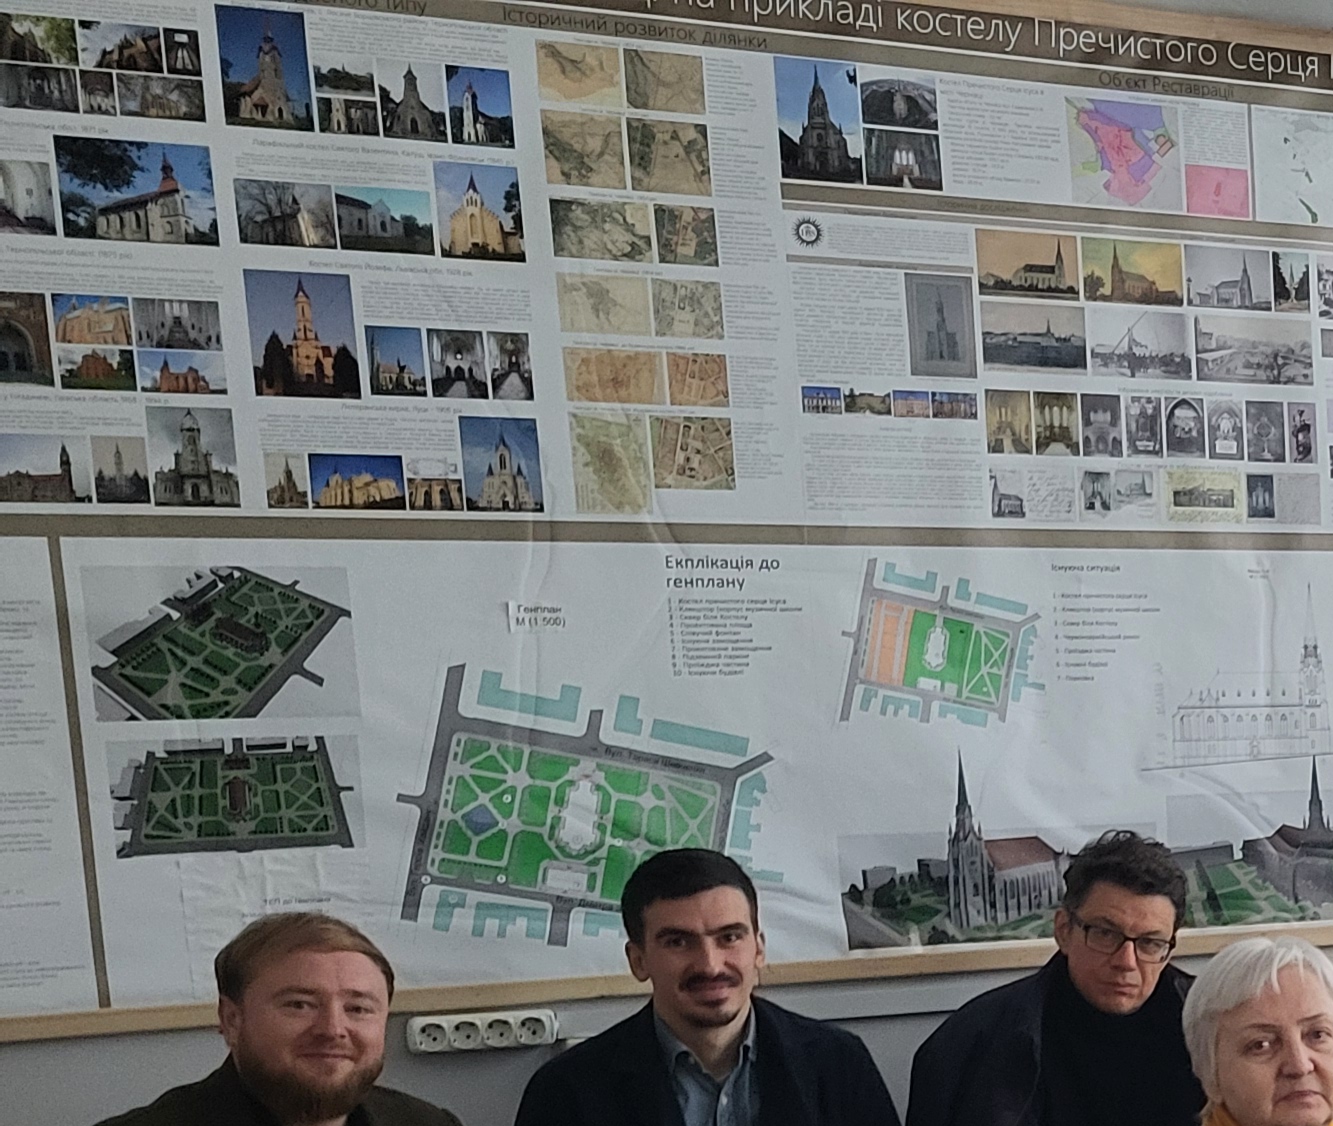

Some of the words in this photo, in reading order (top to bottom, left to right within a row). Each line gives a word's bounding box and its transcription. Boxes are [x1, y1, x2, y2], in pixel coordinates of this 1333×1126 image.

[503, 6, 607, 31] Історичний
[614, 20, 696, 41] розвиток
[702, 30, 768, 49] ділянки
[730, 0, 884, 32] прикладі
[896, 6, 1023, 51] костелу
[1033, 17, 1217, 66] Пречистого
[1226, 42, 1319, 82] Серця
[1099, 71, 1147, 90] Об'єкт
[1152, 78, 1234, 100] Реставрації
[665, 554, 754, 571] Екплікація
[758, 558, 781, 572] до
[666, 577, 745, 591] генплану
[517, 604, 562, 615] Генплан
